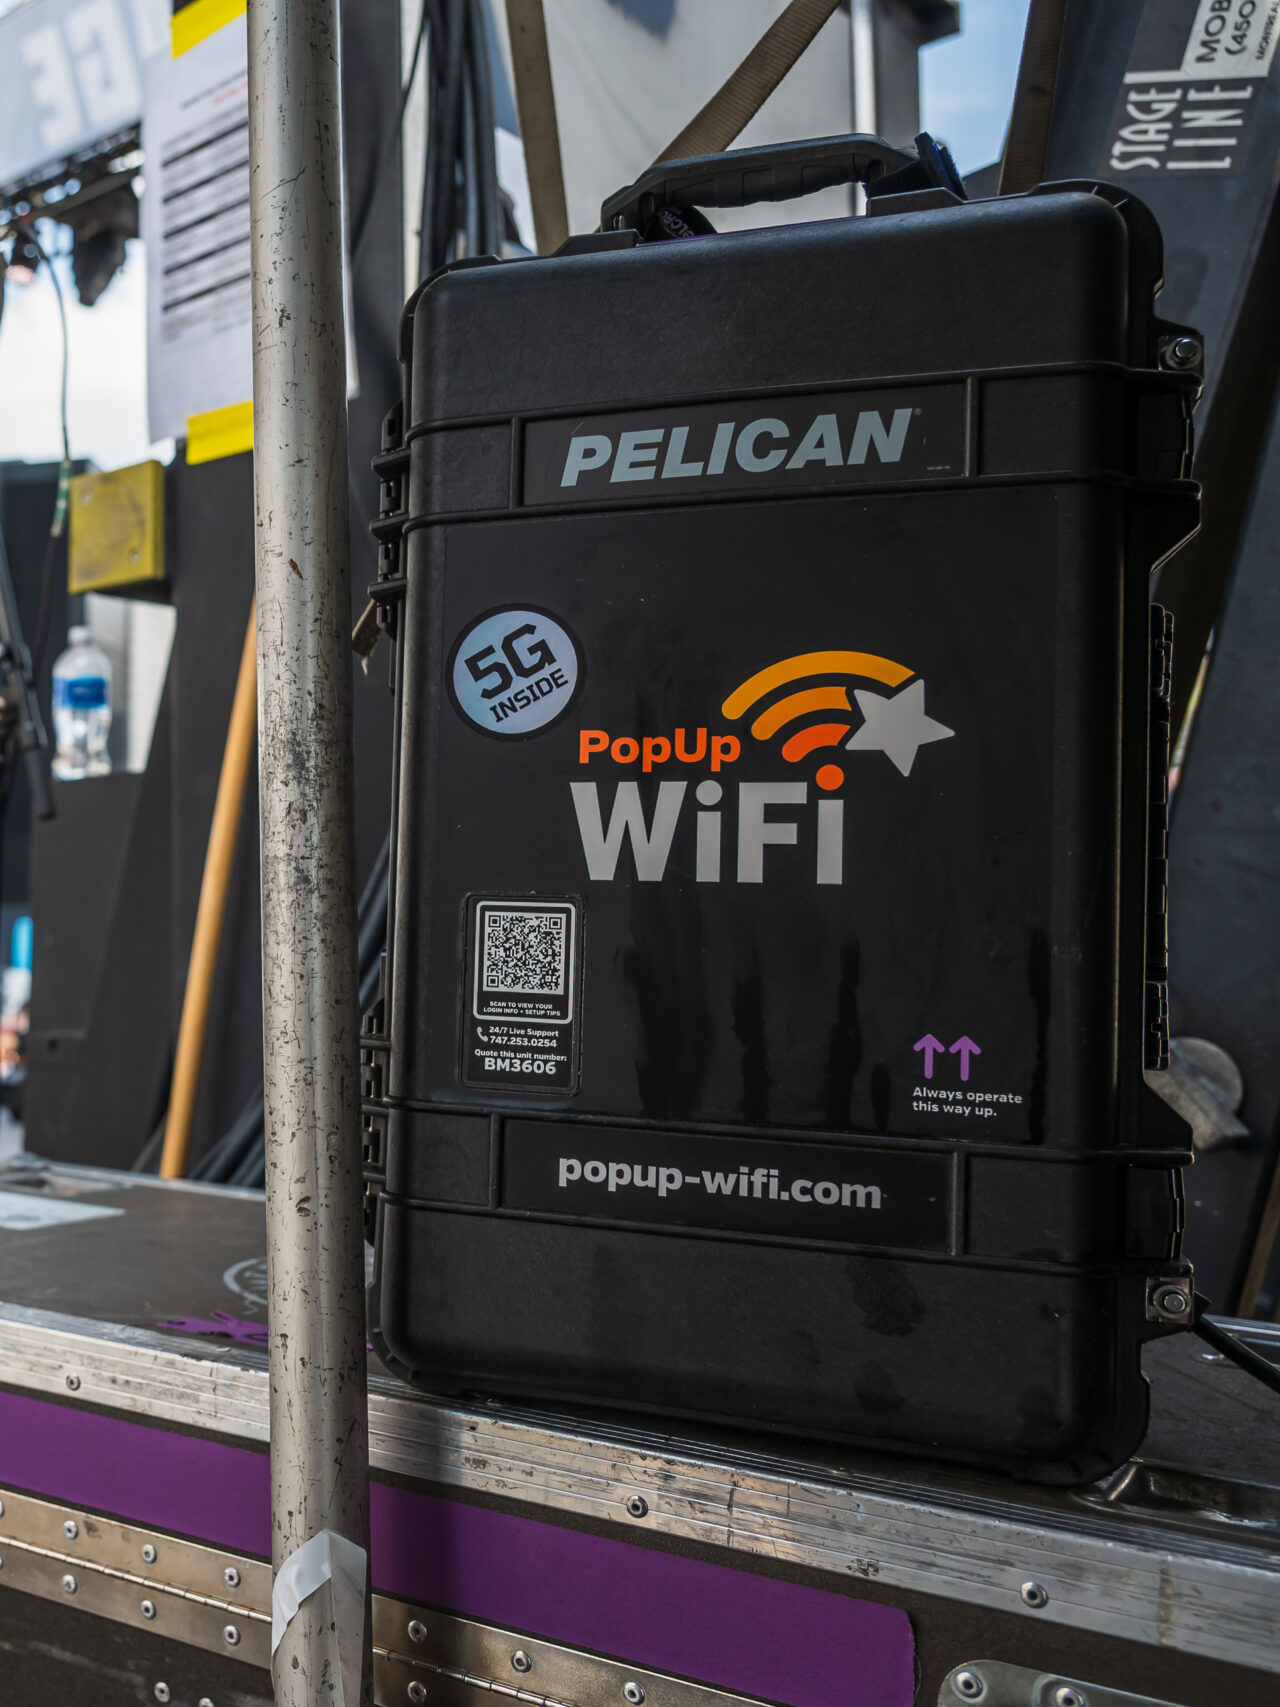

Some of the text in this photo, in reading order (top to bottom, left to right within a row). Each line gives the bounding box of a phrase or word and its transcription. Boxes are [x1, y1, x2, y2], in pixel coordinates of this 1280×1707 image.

[1109, 88, 1182, 170] STAGE
[1166, 85, 1253, 169] LINE
[560, 408, 913, 487] PELICAN
[464, 623, 557, 699] 5G
[489, 668, 569, 723] INSIDE
[579, 727, 741, 773] PopUp
[570, 764, 844, 885] WiFi
[474, 1048, 567, 1061] Quote this unit number:
[489, 1026, 559, 1037] 24/7 Live Support
[490, 1035, 557, 1047] 747.253.0254
[484, 1057, 557, 1075] BM3606
[912, 1087, 1023, 1104] Always operate
[912, 1101, 998, 1118] this way up.
[558, 1157, 882, 1209] popup-wifi.com
